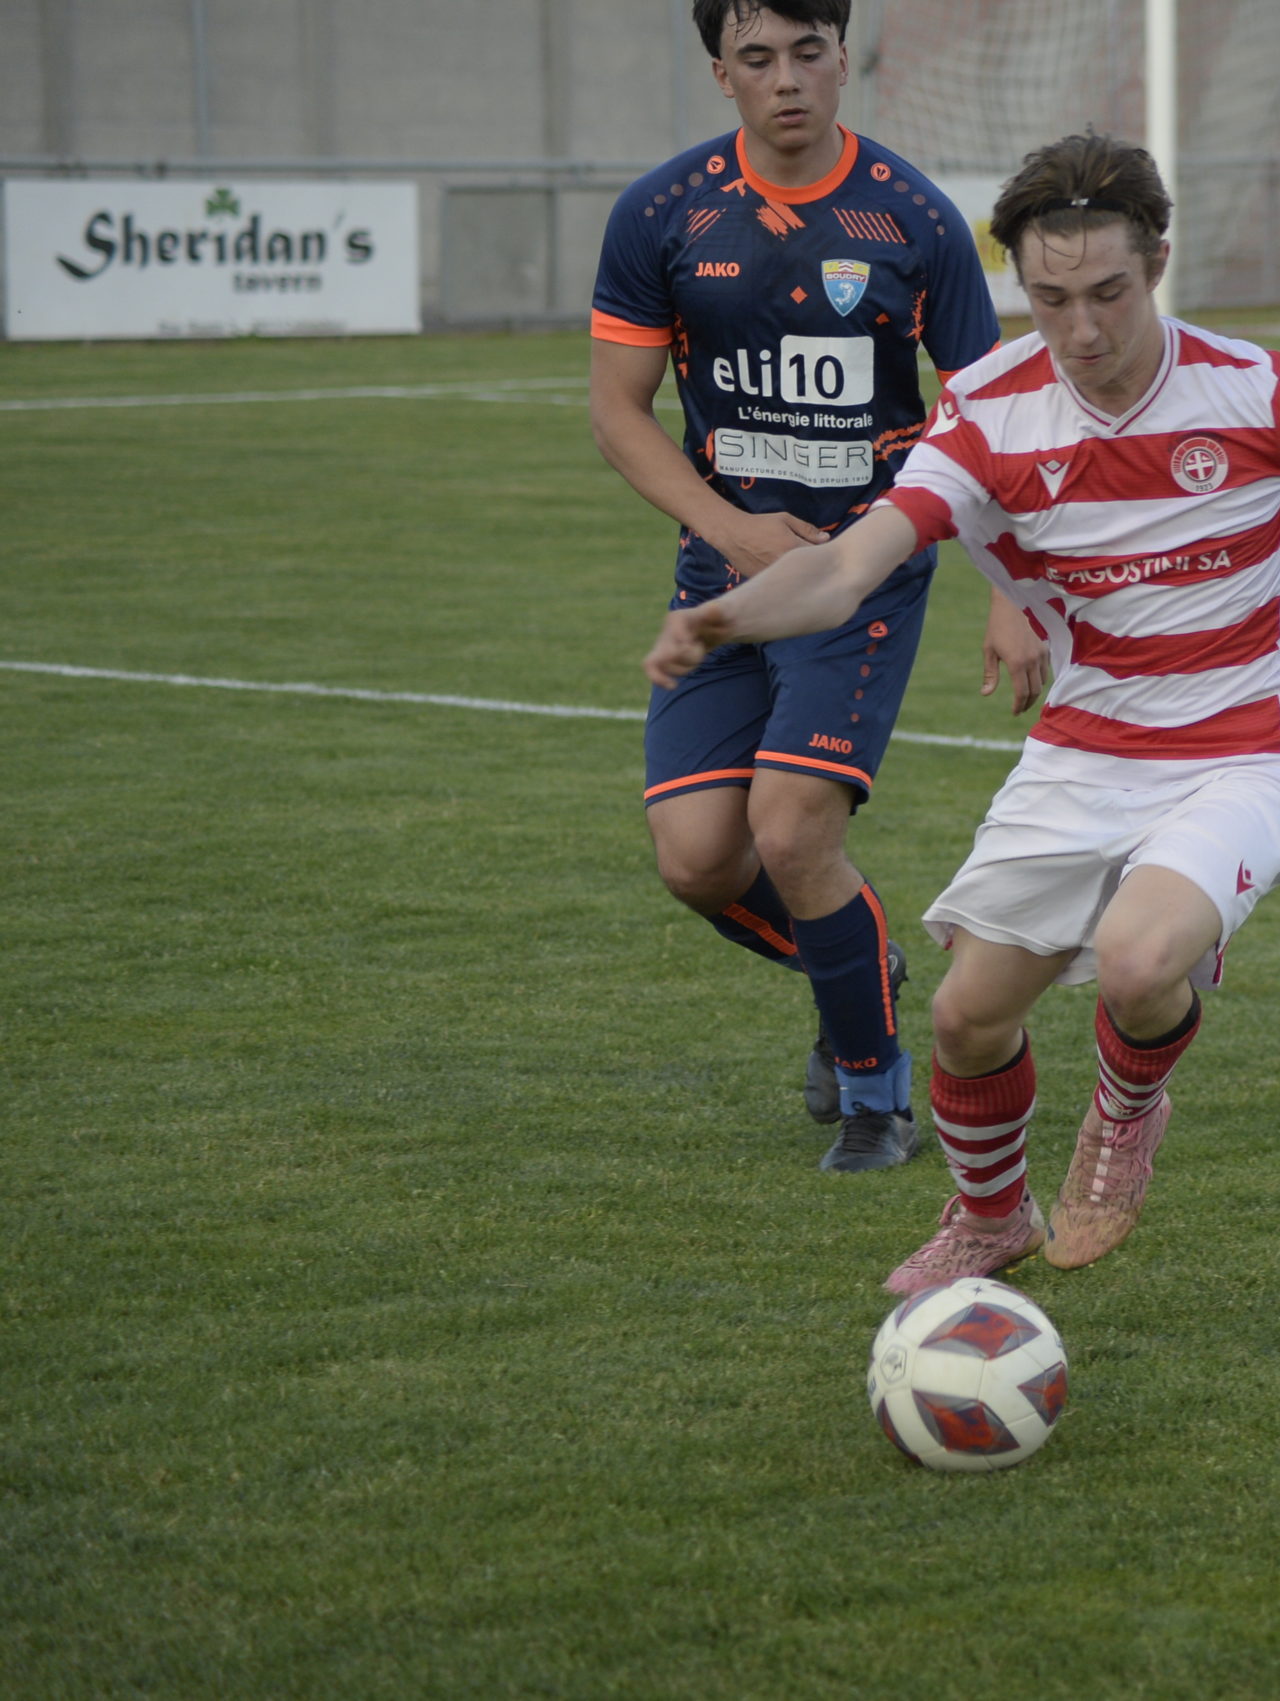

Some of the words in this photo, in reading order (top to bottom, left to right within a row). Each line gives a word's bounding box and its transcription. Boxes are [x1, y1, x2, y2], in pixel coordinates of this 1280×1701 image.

[56, 207, 374, 281] Sheridan's
[694, 262, 740, 278] JAKO
[826, 273, 865, 282] BOUDRY
[233, 272, 322, 294] tavern
[713, 348, 846, 400] eli10
[814, 413, 874, 429] littorale
[719, 434, 869, 468] SINGER
[719, 465, 775, 475] MANUFACTURE
[1197, 550, 1231, 570] SA
[808, 733, 853, 754] JAKO
